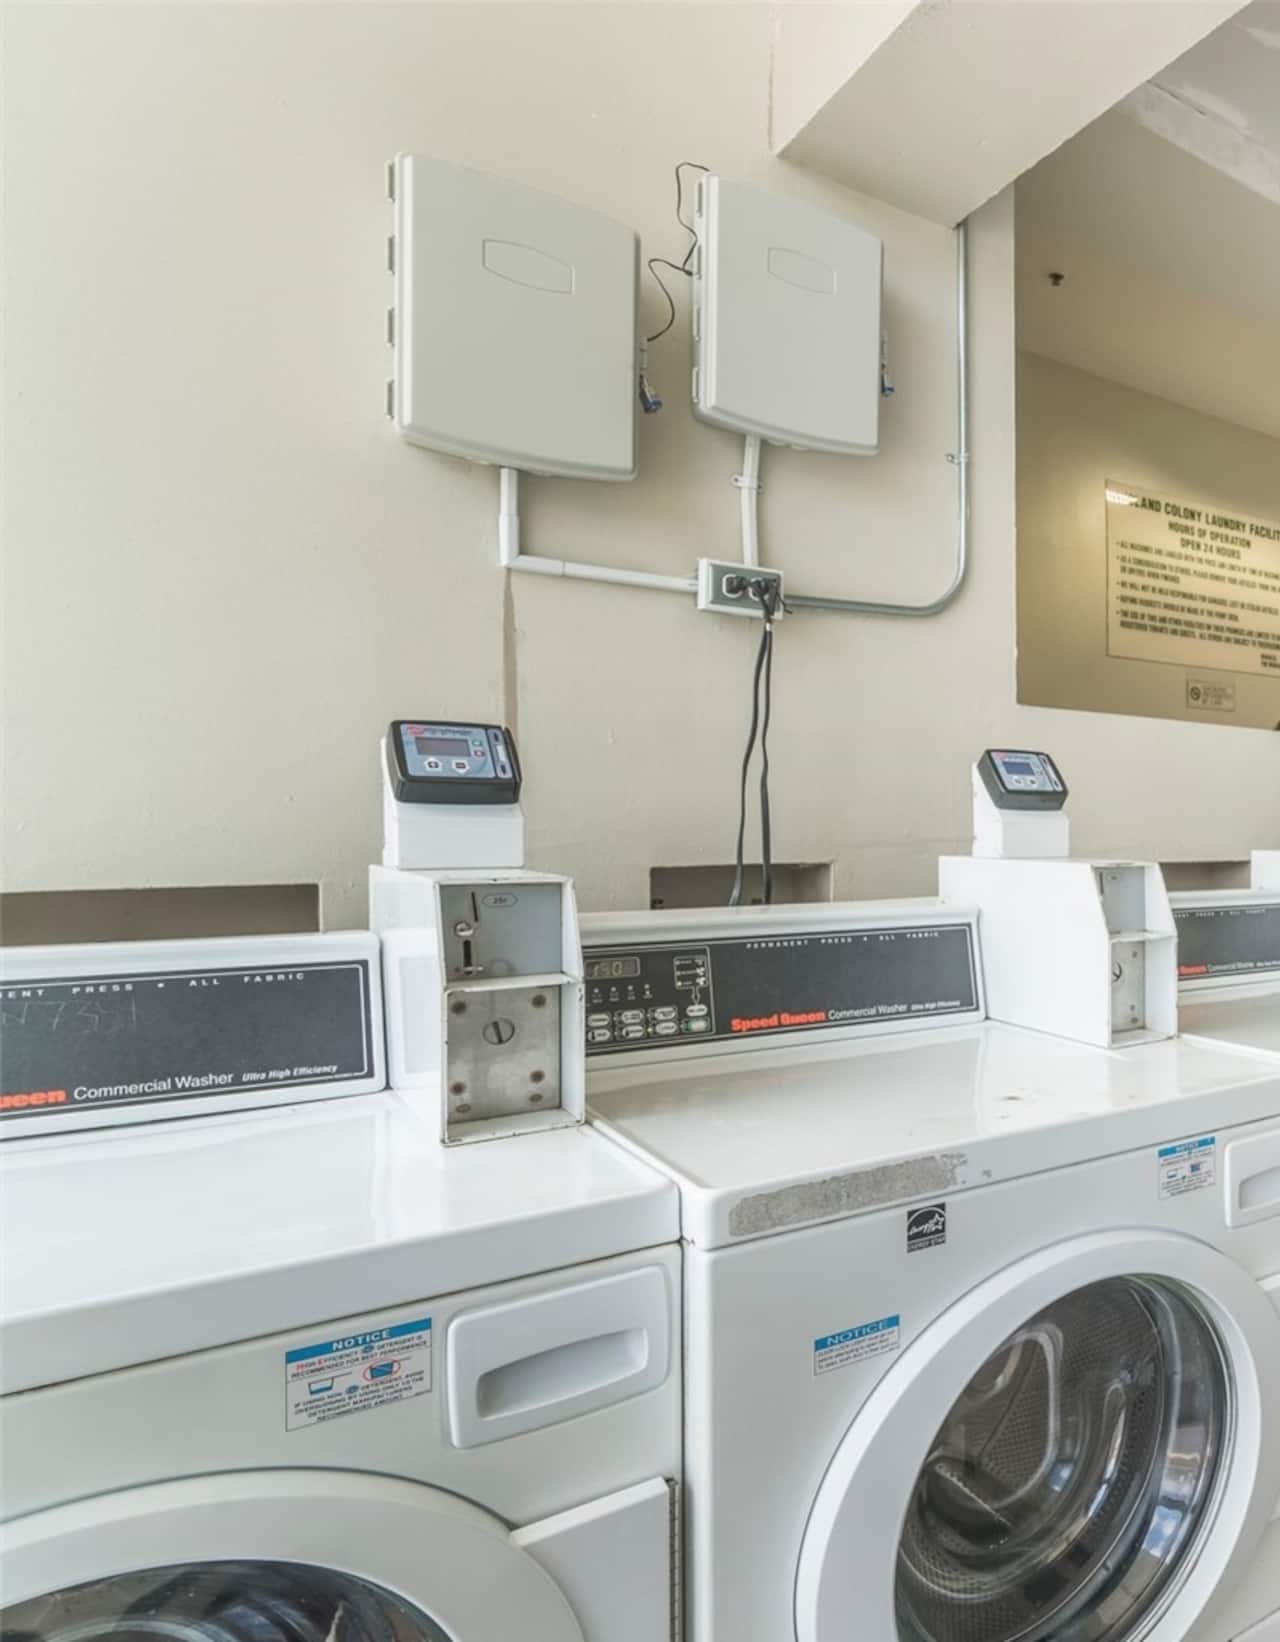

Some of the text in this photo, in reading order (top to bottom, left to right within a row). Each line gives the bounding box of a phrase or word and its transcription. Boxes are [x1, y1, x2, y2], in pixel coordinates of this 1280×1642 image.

[1164, 502, 1202, 523] COLONY
[1205, 512, 1246, 534] LAUNDRY
[1168, 521, 1252, 549] HOURS OF OPERATION
[1180, 537, 1241, 560] OPEN 24 HOURS
[72, 983, 134, 995] PRESS
[189, 978, 221, 987] ALL
[243, 972, 306, 982] FABRIC
[731, 1014, 779, 1031] Speed
[780, 1011, 827, 1026] Queen
[828, 1005, 876, 1020] Commercial
[878, 1003, 908, 1015] Washer
[73, 1078, 172, 1100] Commercial
[174, 1071, 234, 1090] Washer
[241, 1072, 267, 1082] Ultra
[268, 1068, 291, 1079] High
[293, 1065, 338, 1077] Efficiency
[332, 1329, 391, 1350] NOTICE
